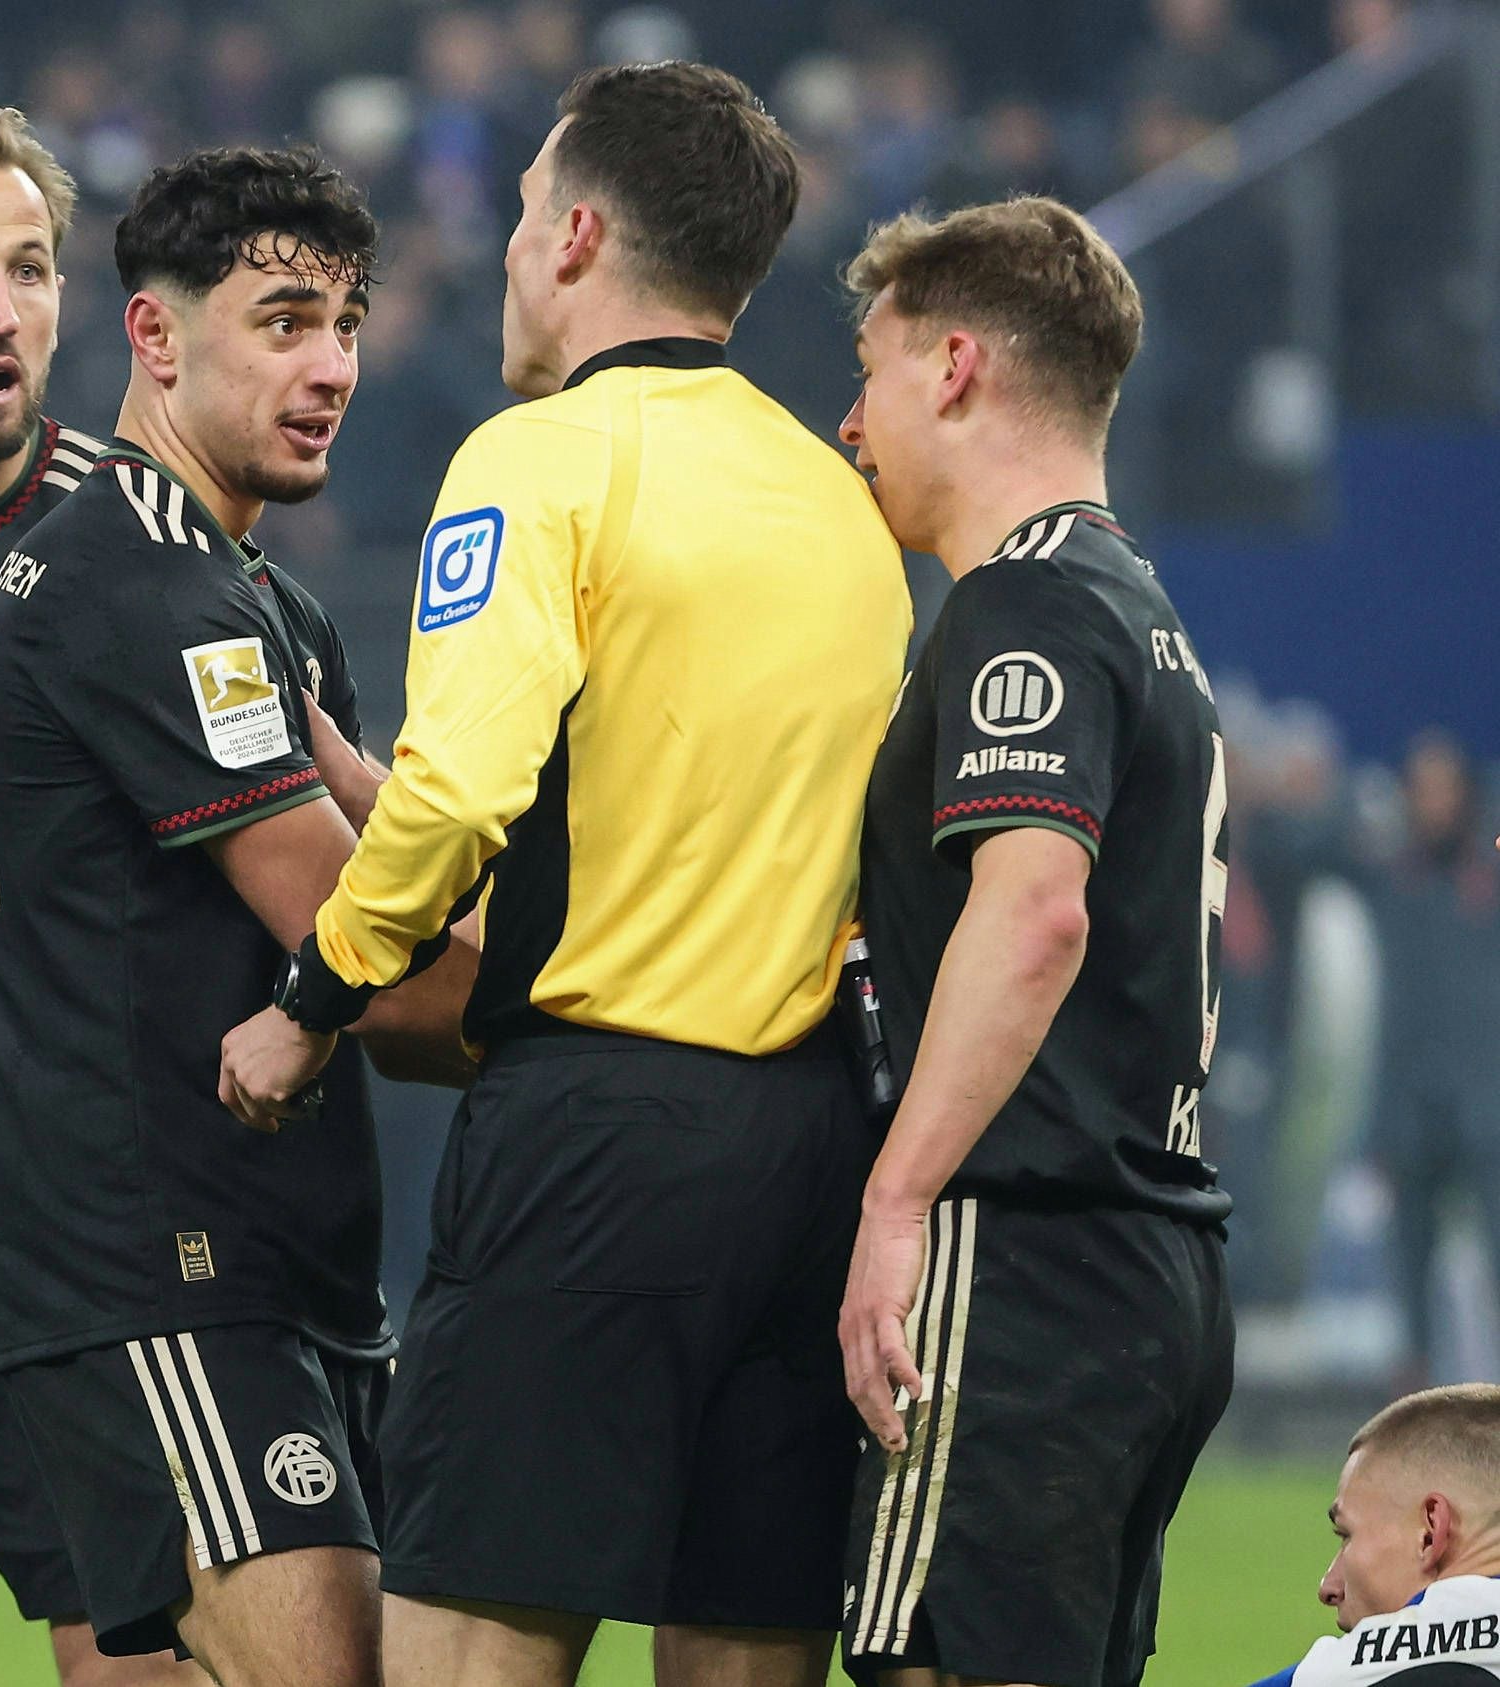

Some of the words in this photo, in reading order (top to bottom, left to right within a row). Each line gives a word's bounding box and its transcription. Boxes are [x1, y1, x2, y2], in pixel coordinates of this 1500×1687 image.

[423, 613, 442, 627] Das
[210, 702, 278, 729] BUNDESLIGA
[219, 733, 283, 757] FUSSBALLMEISTER
[229, 728, 273, 746] DEUTSCHER
[237, 744, 275, 760] 2024/2025
[956, 745, 1066, 780] Allianz
[1350, 1614, 1500, 1666] HAMB
